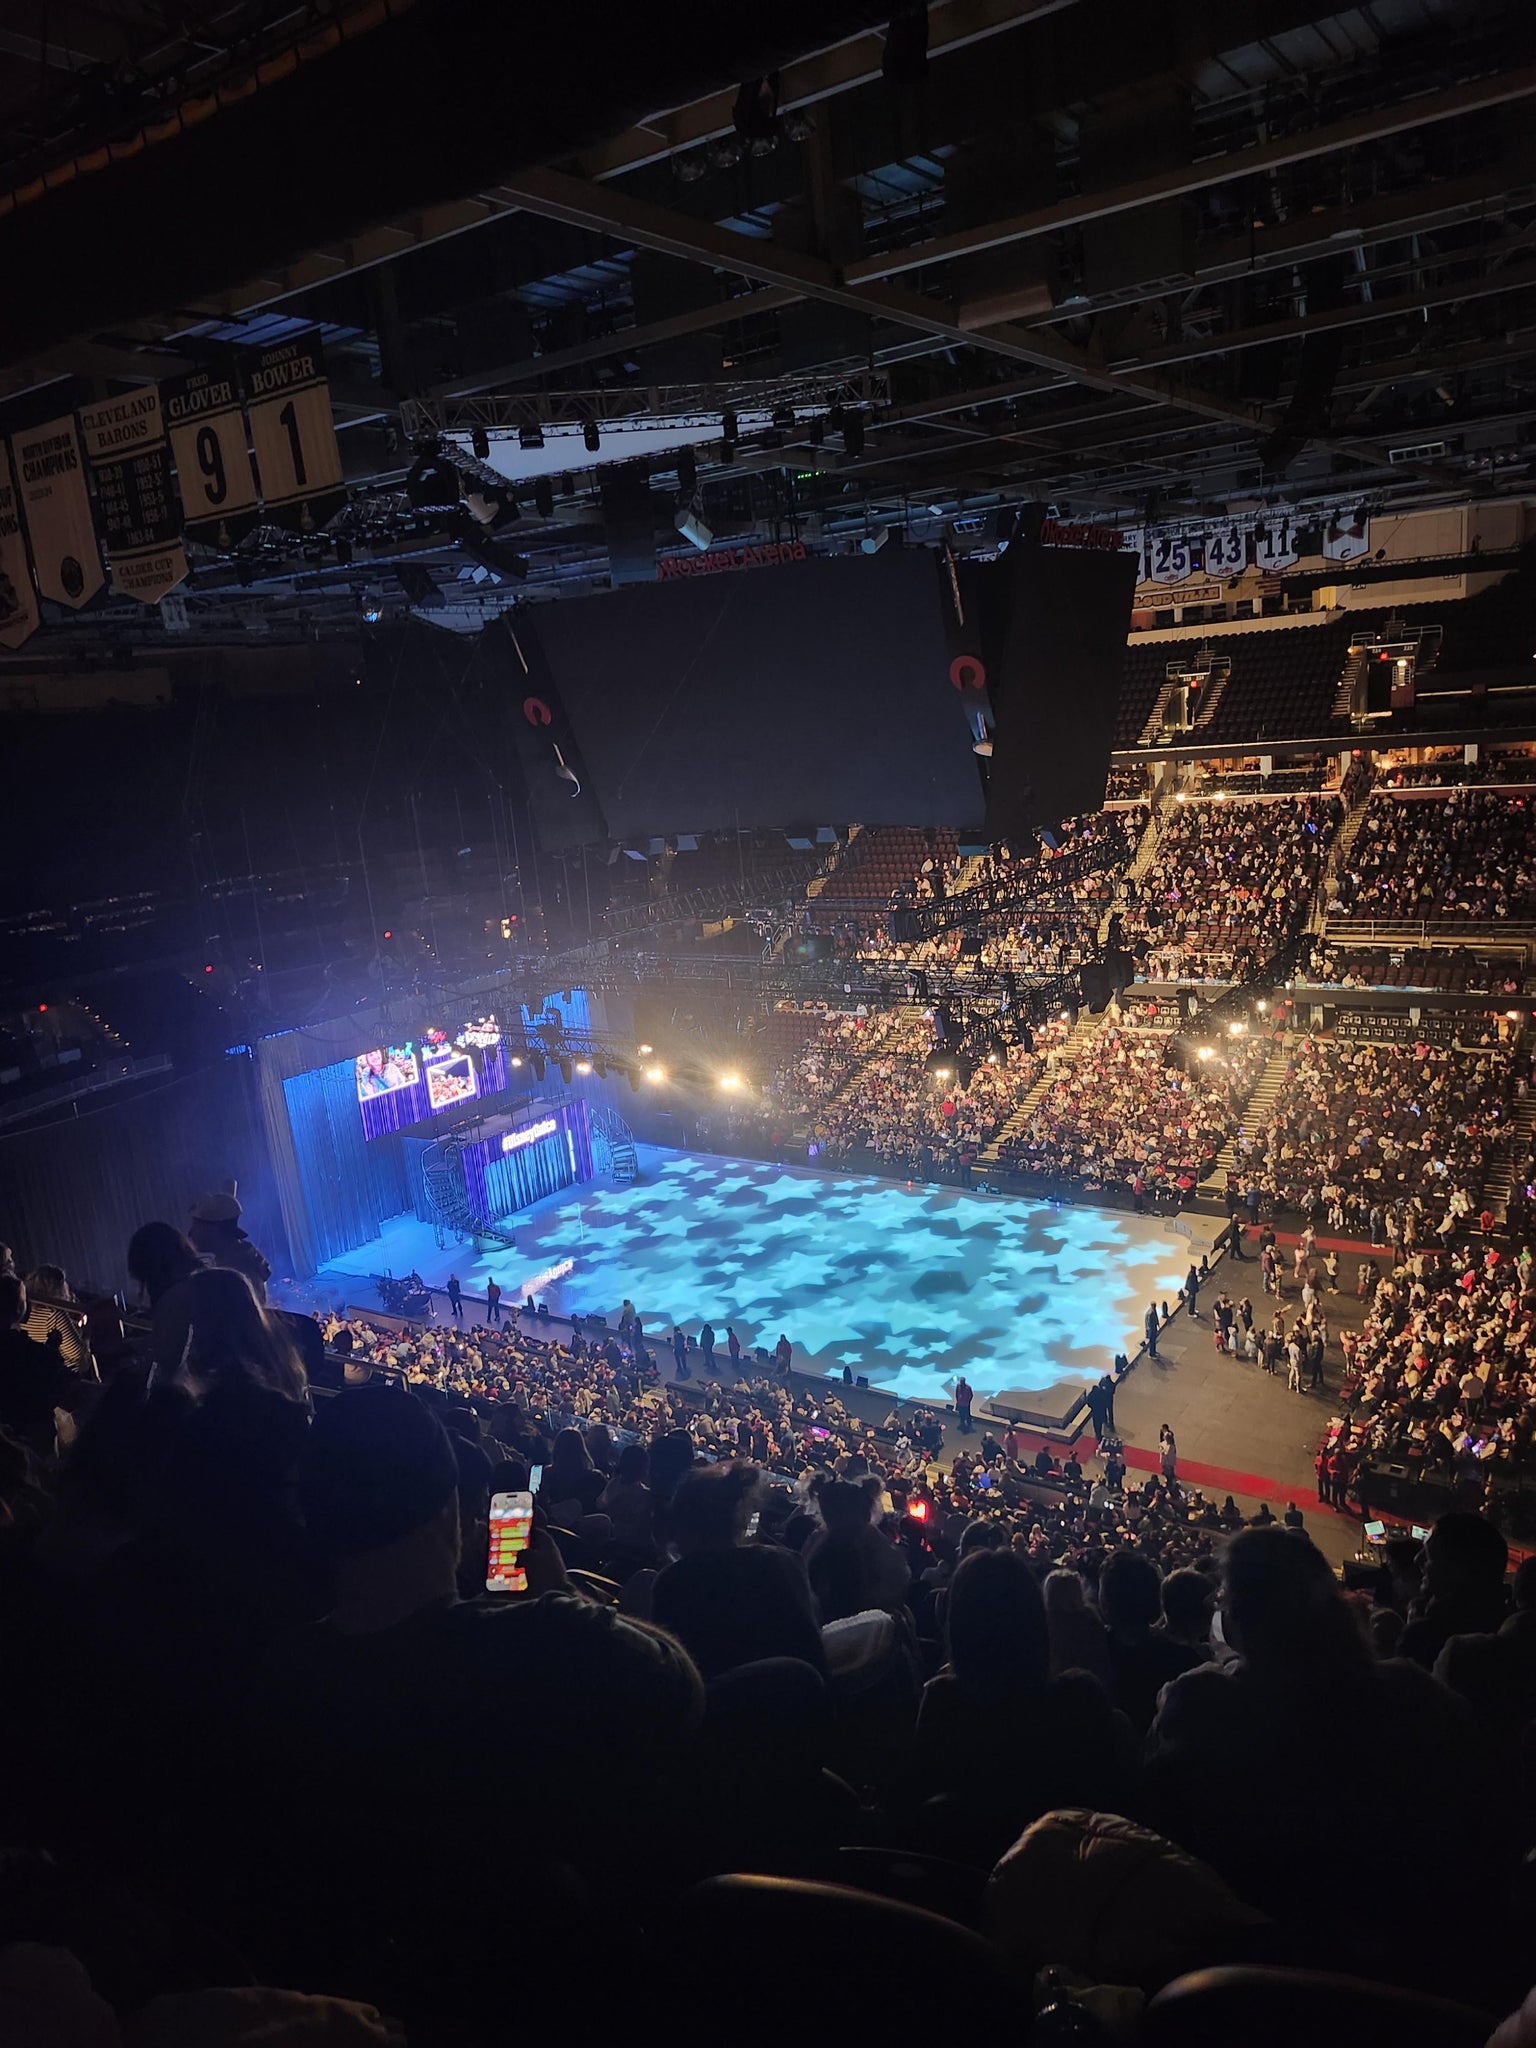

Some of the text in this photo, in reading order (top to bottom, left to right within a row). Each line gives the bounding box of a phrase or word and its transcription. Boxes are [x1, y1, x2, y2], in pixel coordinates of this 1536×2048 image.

[261, 344, 298, 367] JOHNNY
[186, 374, 209, 390] FRED
[251, 356, 315, 393] BOWER
[83, 394, 156, 431] CLEVELAND
[169, 382, 232, 418] GLOVER
[97, 420, 148, 448] BARONS
[279, 401, 307, 486] 1
[23, 448, 77, 483] CHAMPIONS
[196, 426, 227, 505] 9
[662, 541, 807, 579] Rocket Arena
[1155, 541, 1186, 574] 25
[1210, 535, 1241, 565] 43
[1264, 531, 1290, 559] 11
[119, 558, 173, 577] CALDER CUP
[122, 572, 173, 590] CHAMPIONS
